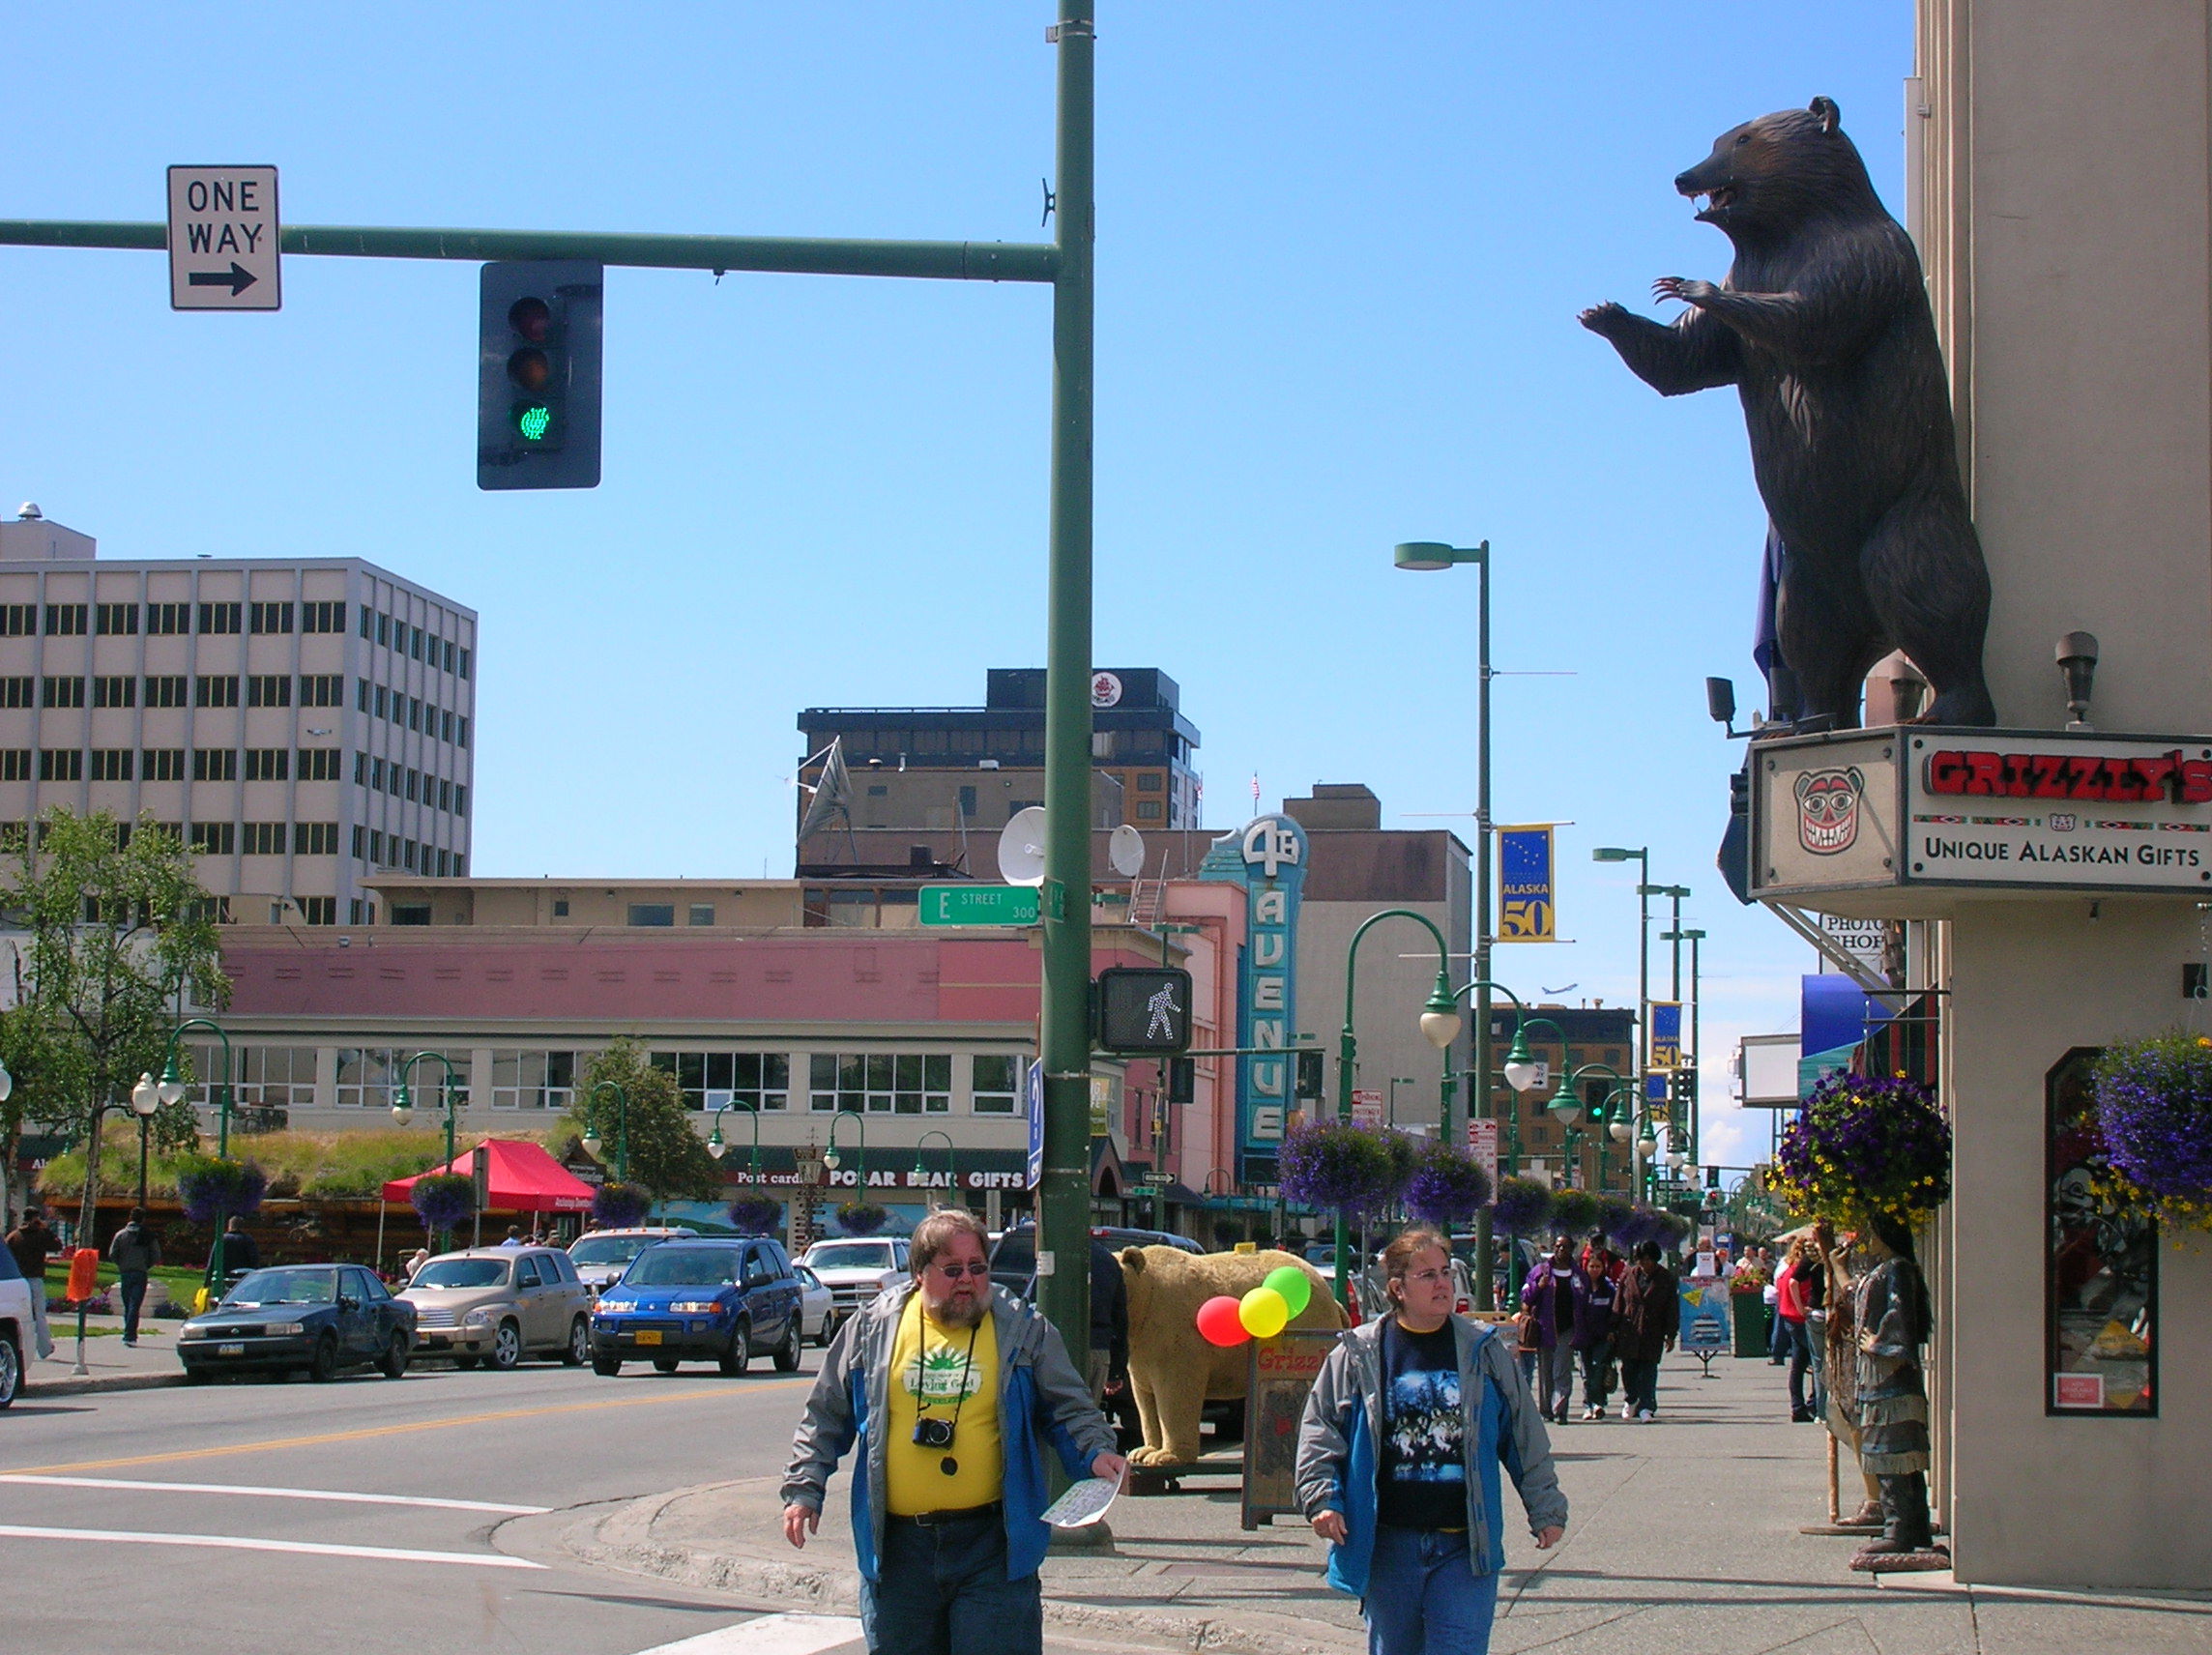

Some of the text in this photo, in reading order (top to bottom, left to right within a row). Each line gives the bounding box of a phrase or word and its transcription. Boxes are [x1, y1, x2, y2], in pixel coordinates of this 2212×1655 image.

[188, 181, 259, 212] ONE
[188, 223, 263, 253] WAY
[1932, 749, 2212, 804] GRIZZLY'S
[1503, 884, 1549, 894] ALASKA
[940, 892, 1003, 918] E STREET
[1012, 907, 1035, 918] 300
[1500, 900, 1552, 937] 50
[1830, 935, 1884, 948] HOP
[1254, 890, 1284, 1140] AVENUE
[738, 1172, 768, 1183] Post
[830, 1170, 1024, 1188] POLAR BEAR GIFTS
